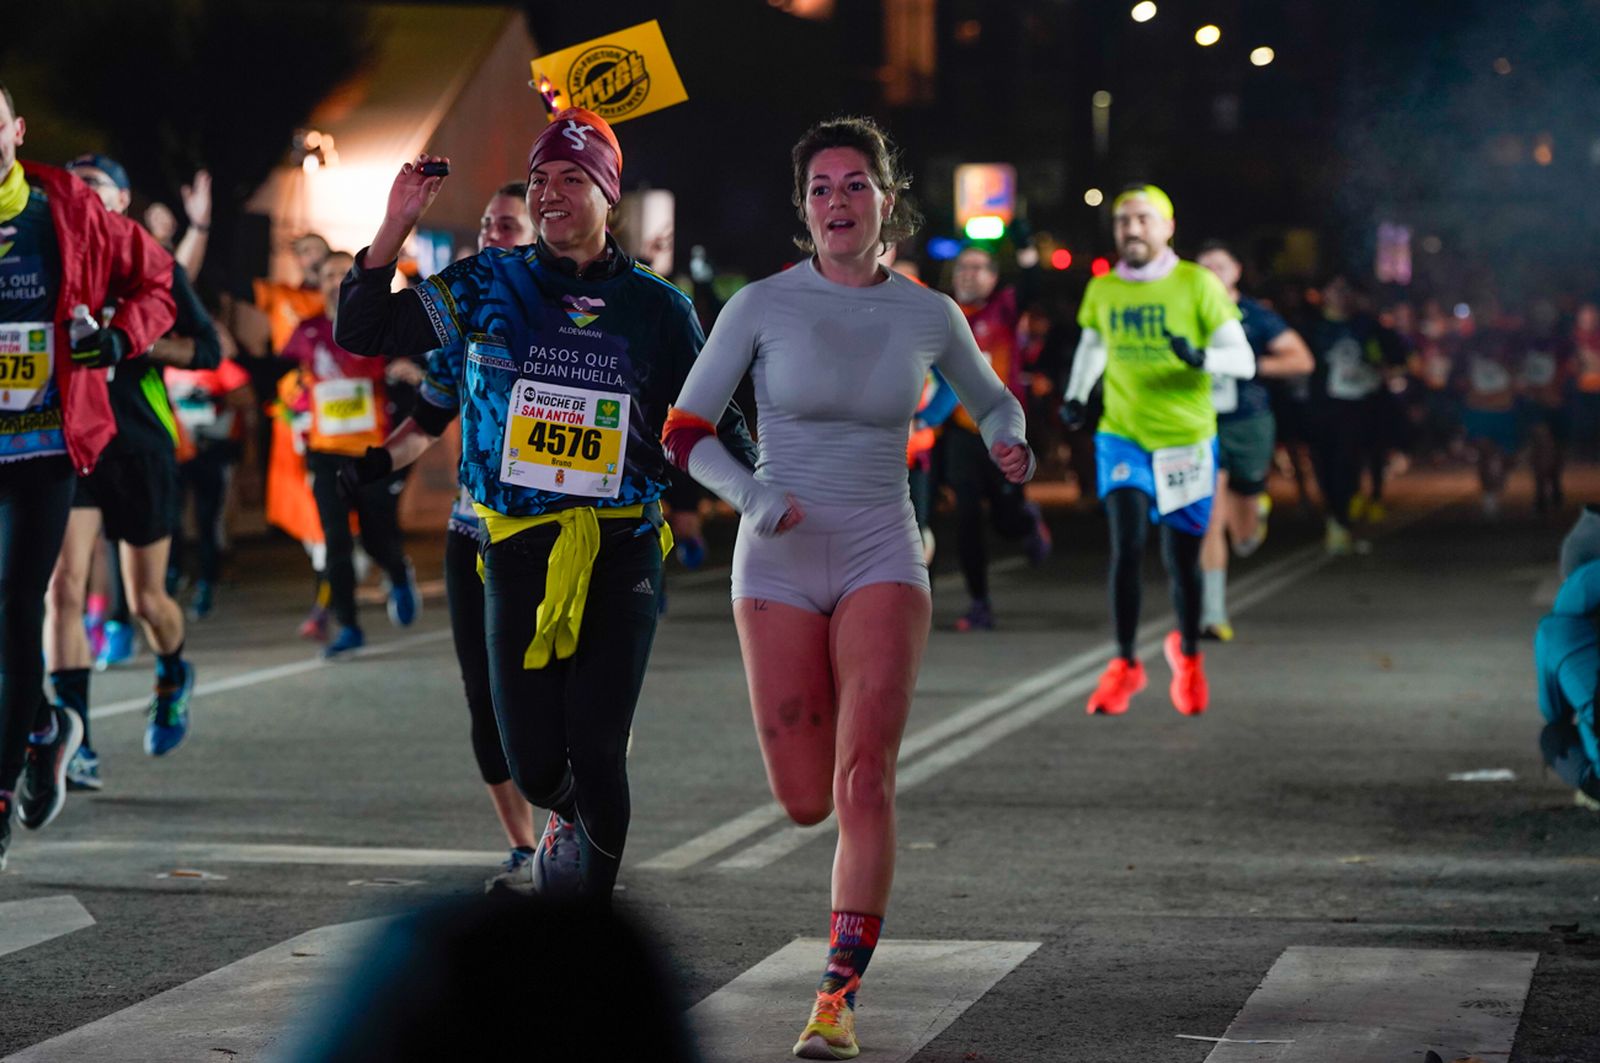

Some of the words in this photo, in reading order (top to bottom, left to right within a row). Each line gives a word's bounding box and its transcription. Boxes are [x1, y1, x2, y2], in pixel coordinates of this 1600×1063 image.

[558, 326, 602, 339] ALDEVARAN
[529, 345, 579, 363] PASOS
[585, 353, 618, 369] QUE
[523, 361, 568, 378] DEJAN
[571, 367, 623, 387] HUELLA
[536, 394, 571, 409] NOCHE
[572, 400, 586, 411] DE
[521, 404, 544, 418] SAN
[545, 410, 585, 425] ANTÓN
[528, 421, 602, 460] 4576
